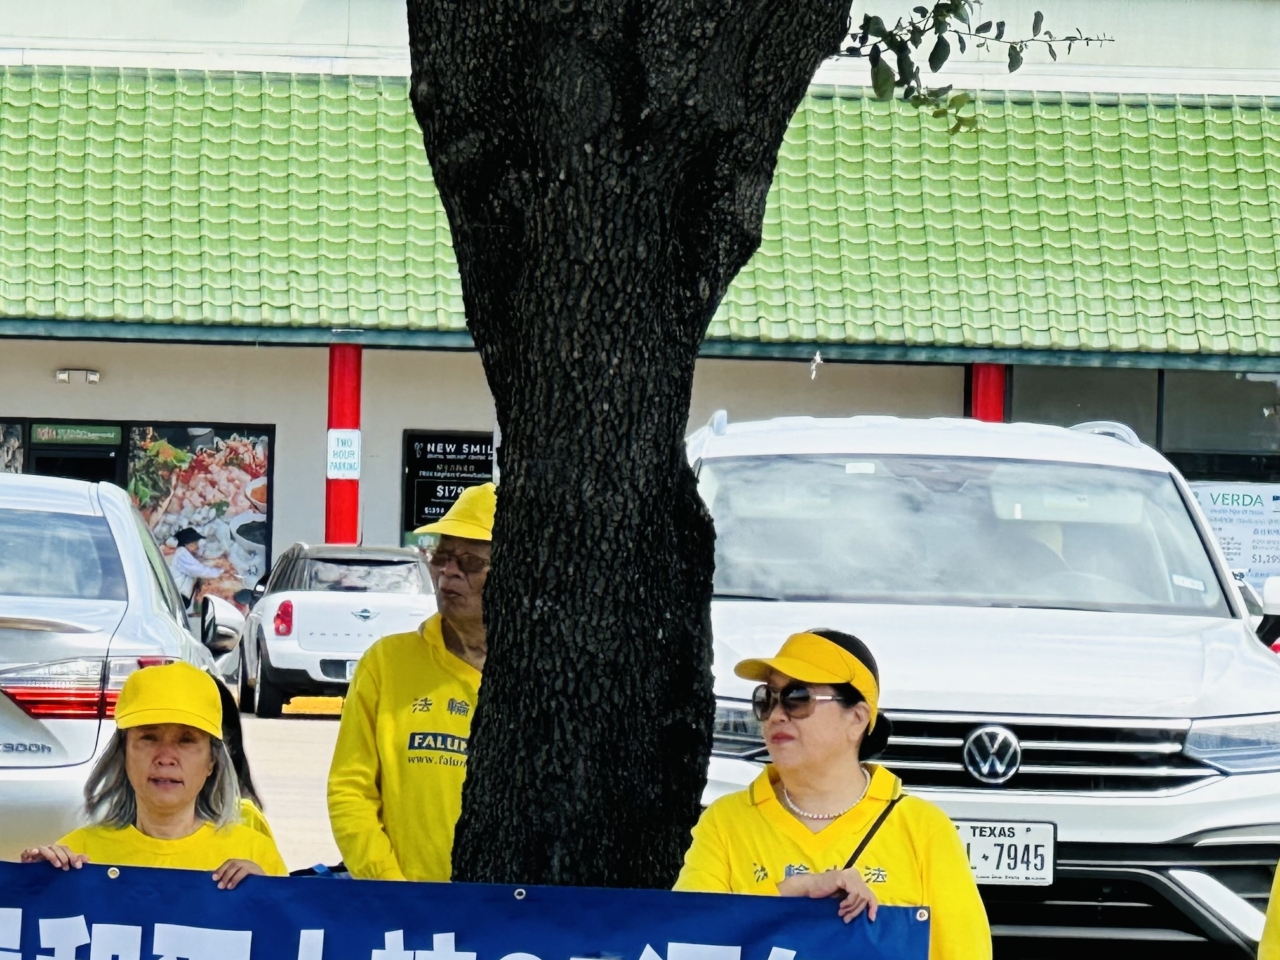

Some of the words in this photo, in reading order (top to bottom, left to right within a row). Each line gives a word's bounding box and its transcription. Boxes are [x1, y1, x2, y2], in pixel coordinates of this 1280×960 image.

[336, 437, 353, 448] TWO
[426, 442, 456, 453] NEW
[332, 450, 356, 460] HOUR
[1210, 492, 1264, 507] VERDA
[970, 826, 1015, 838] TEXAS
